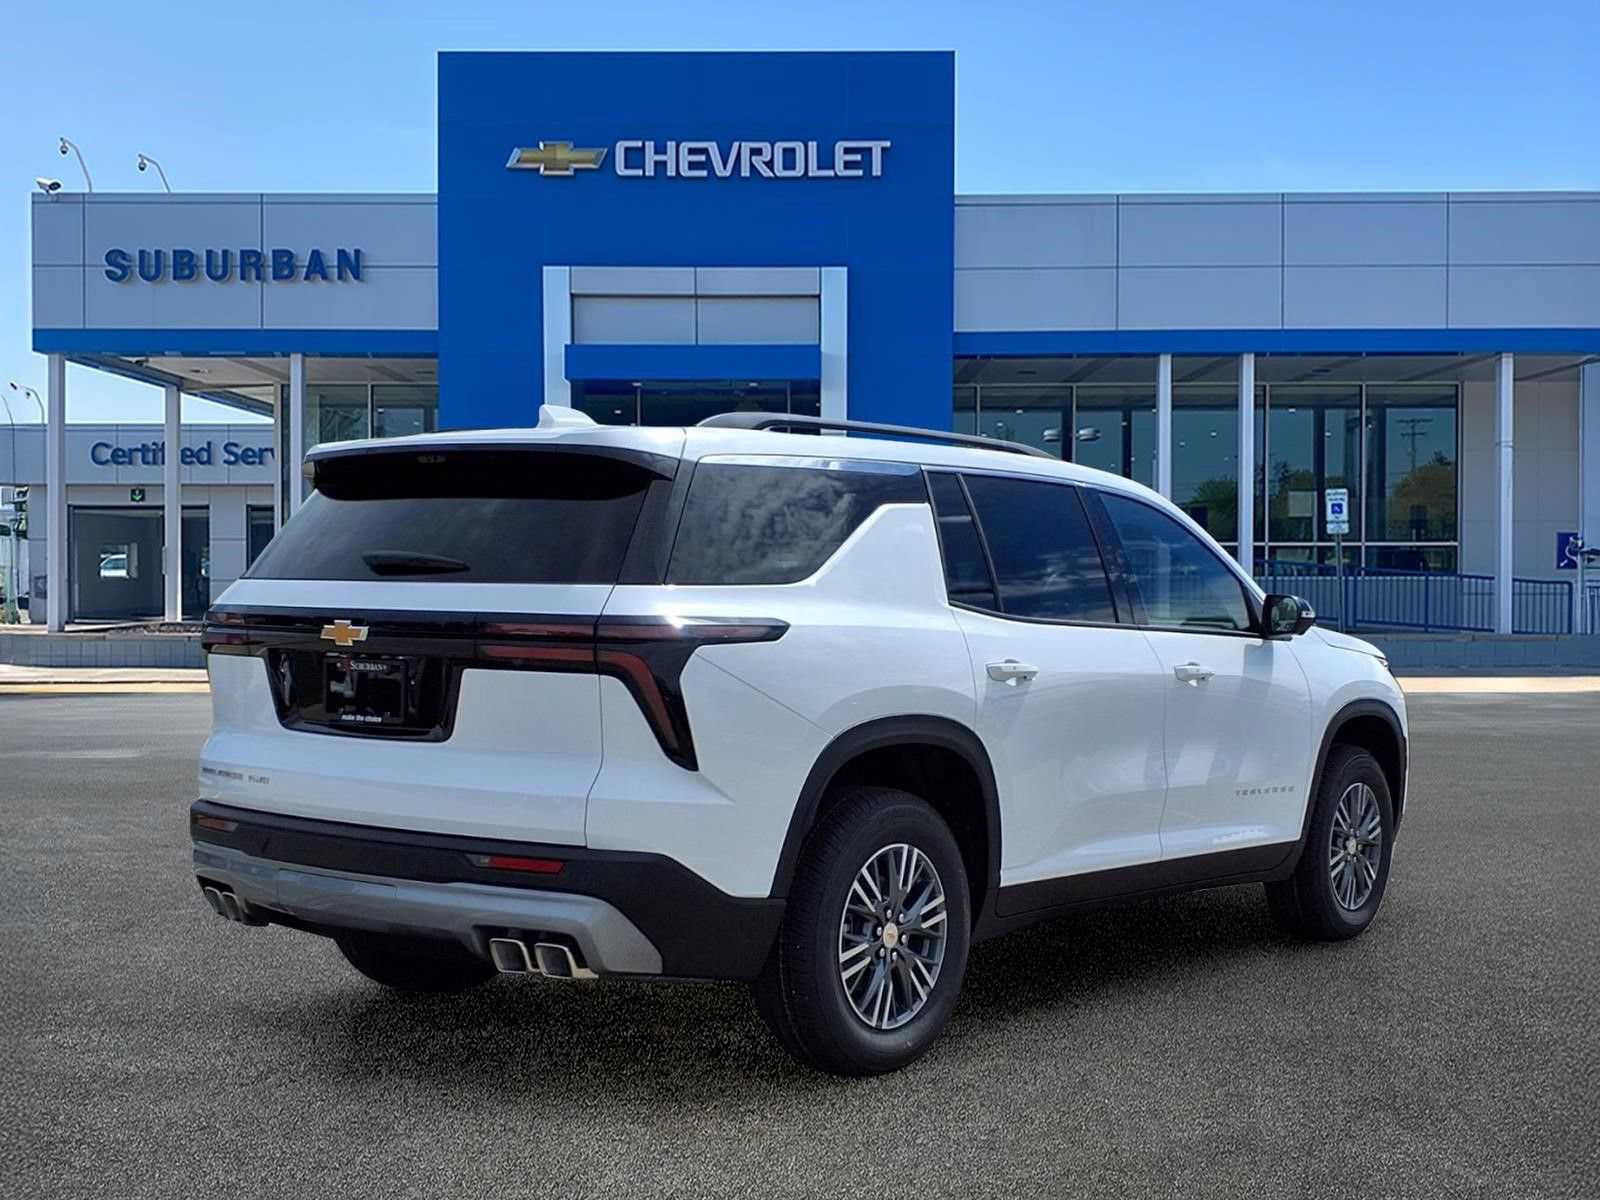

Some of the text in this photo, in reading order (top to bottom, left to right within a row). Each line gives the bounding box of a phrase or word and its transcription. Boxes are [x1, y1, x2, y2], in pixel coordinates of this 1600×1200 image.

[615, 140, 891, 178] CHEVROLET
[104, 248, 362, 283] SUBURBAN
[91, 441, 213, 466] Certifed
